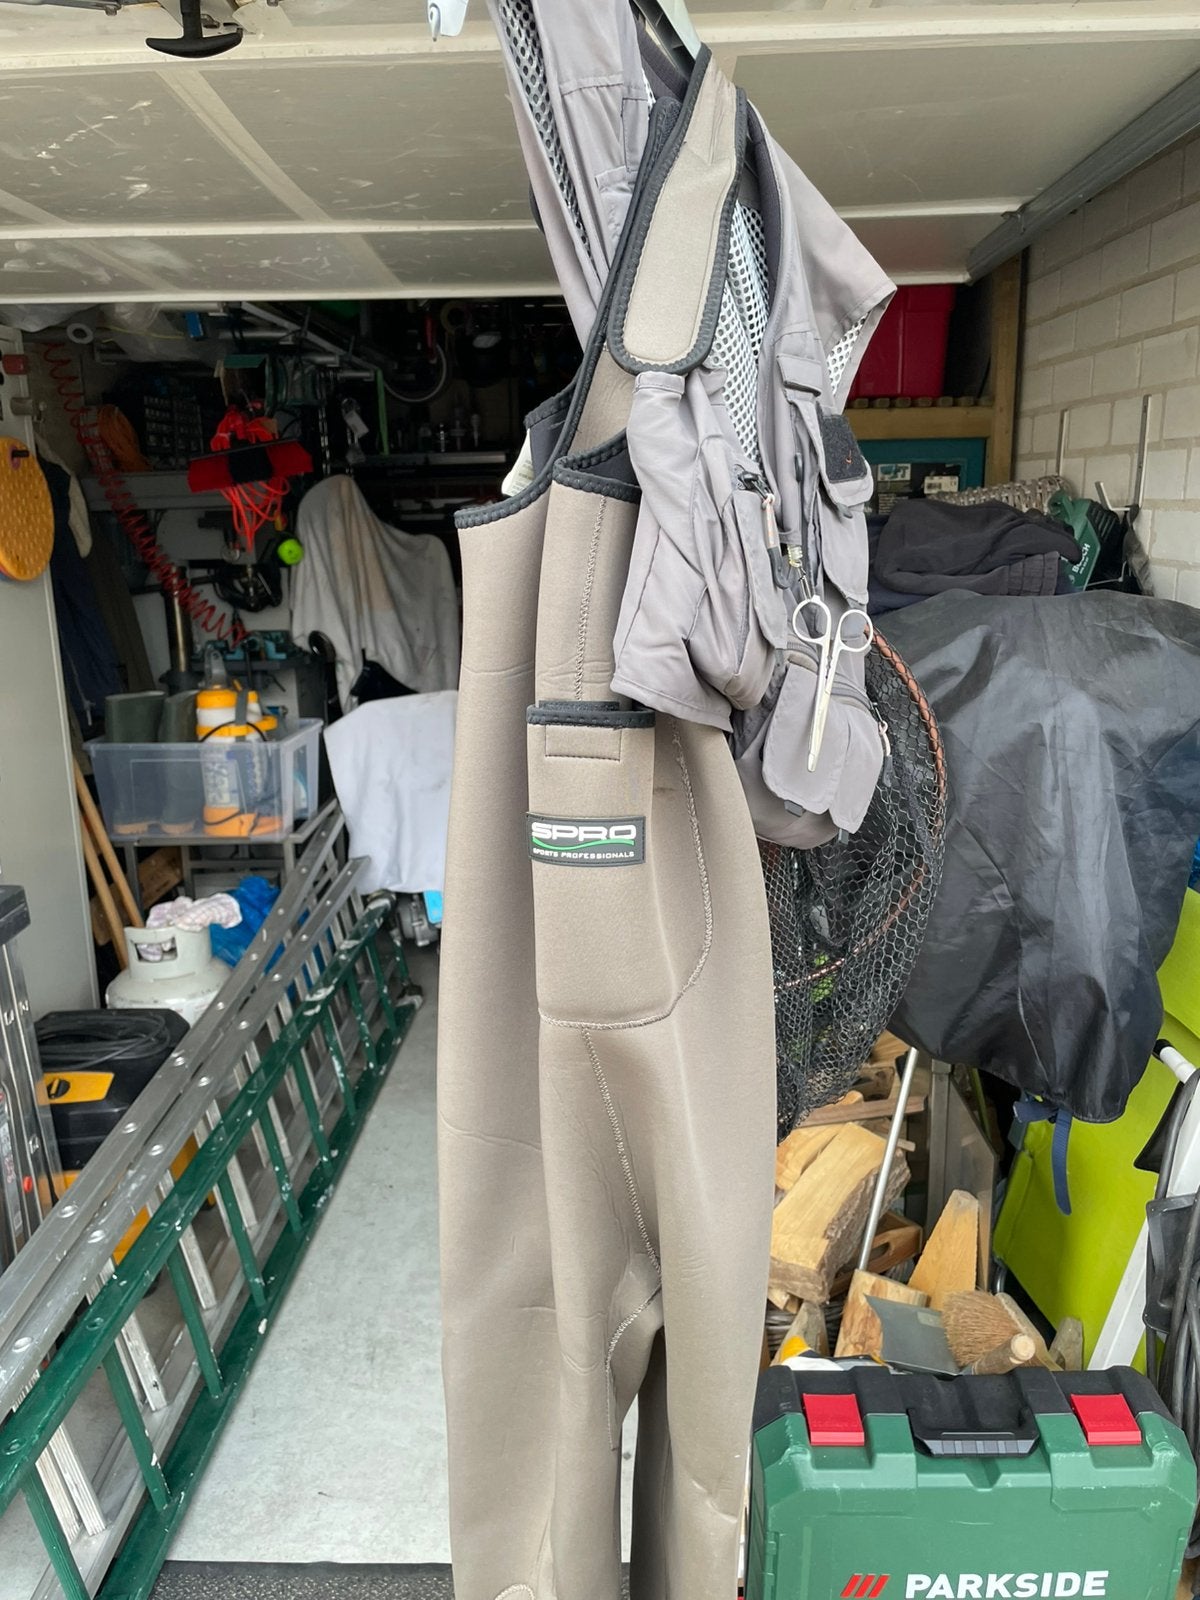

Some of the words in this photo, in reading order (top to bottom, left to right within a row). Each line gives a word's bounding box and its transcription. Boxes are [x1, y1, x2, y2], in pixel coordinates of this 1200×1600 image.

[531, 821, 637, 841] SPRO
[532, 847, 559, 858] SPORTS
[560, 851, 635, 860] PROFESSIONALS
[905, 1570, 1109, 1599] PARKSIDE
